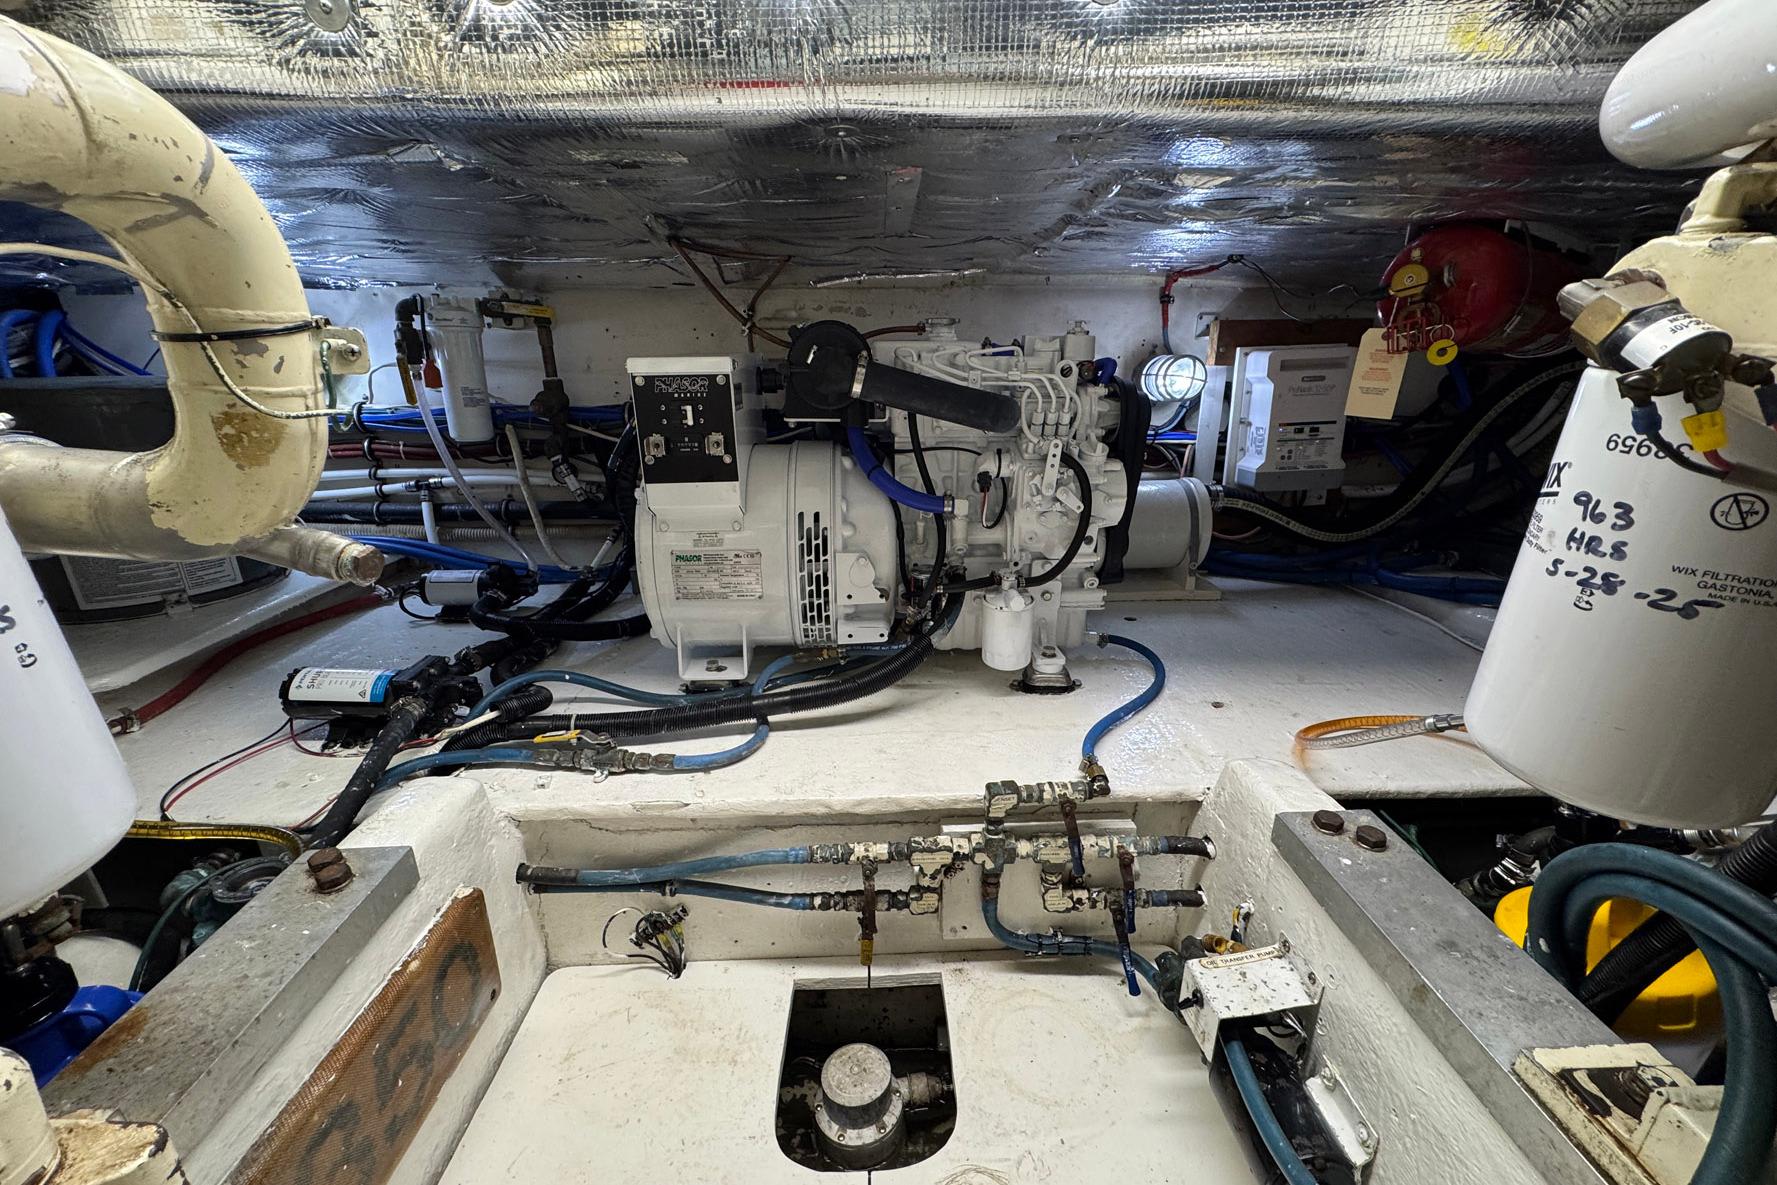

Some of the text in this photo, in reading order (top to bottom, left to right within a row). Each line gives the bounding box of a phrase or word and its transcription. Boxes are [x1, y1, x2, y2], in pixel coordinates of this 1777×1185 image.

[655, 376, 709, 392] PHASOR
[1573, 490, 1635, 531] 963
[1565, 527, 1629, 561] HRS
[675, 554, 702, 563] PHASOR
[1671, 564, 1699, 578] WIX
[1707, 592, 1737, 603] MADE
[1220, 954, 1255, 965] TRANSFER
[1257, 950, 1276, 958] PUMP
